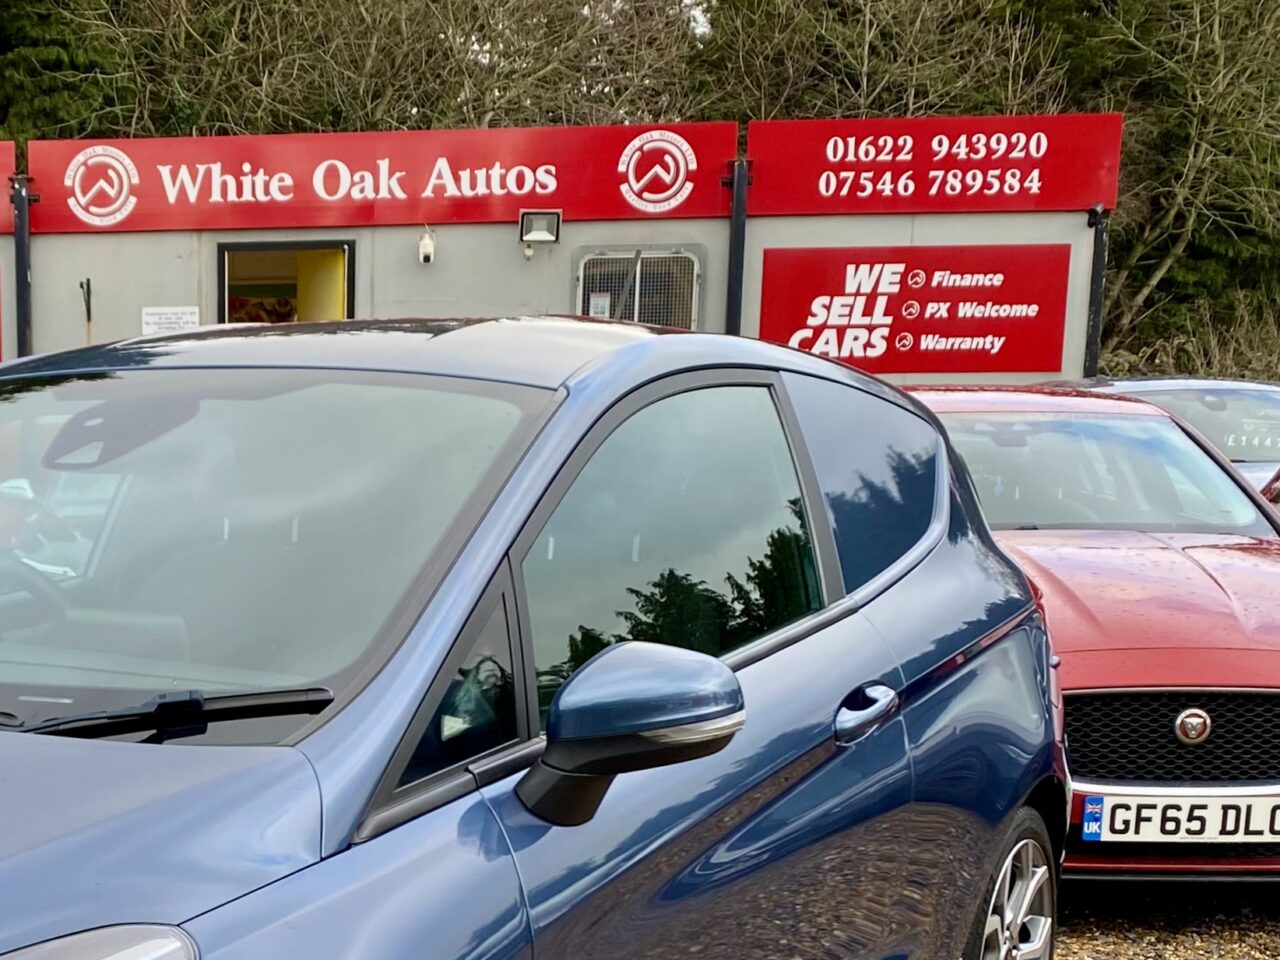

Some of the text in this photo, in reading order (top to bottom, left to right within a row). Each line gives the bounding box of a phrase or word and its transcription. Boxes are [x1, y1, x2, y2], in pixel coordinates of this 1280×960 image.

[825, 131, 1048, 163] 01622 943920
[156, 156, 558, 204] White Oak Autos
[818, 168, 1042, 198] 07546 789584
[844, 263, 905, 294] WE
[930, 269, 1005, 288] Finance
[806, 295, 894, 327] SELL
[923, 301, 1040, 319] PX Welcome
[787, 327, 890, 358] CARS
[919, 333, 1006, 356] Warranty
[1083, 821, 1102, 834] UK
[1108, 803, 1209, 837] GF65
